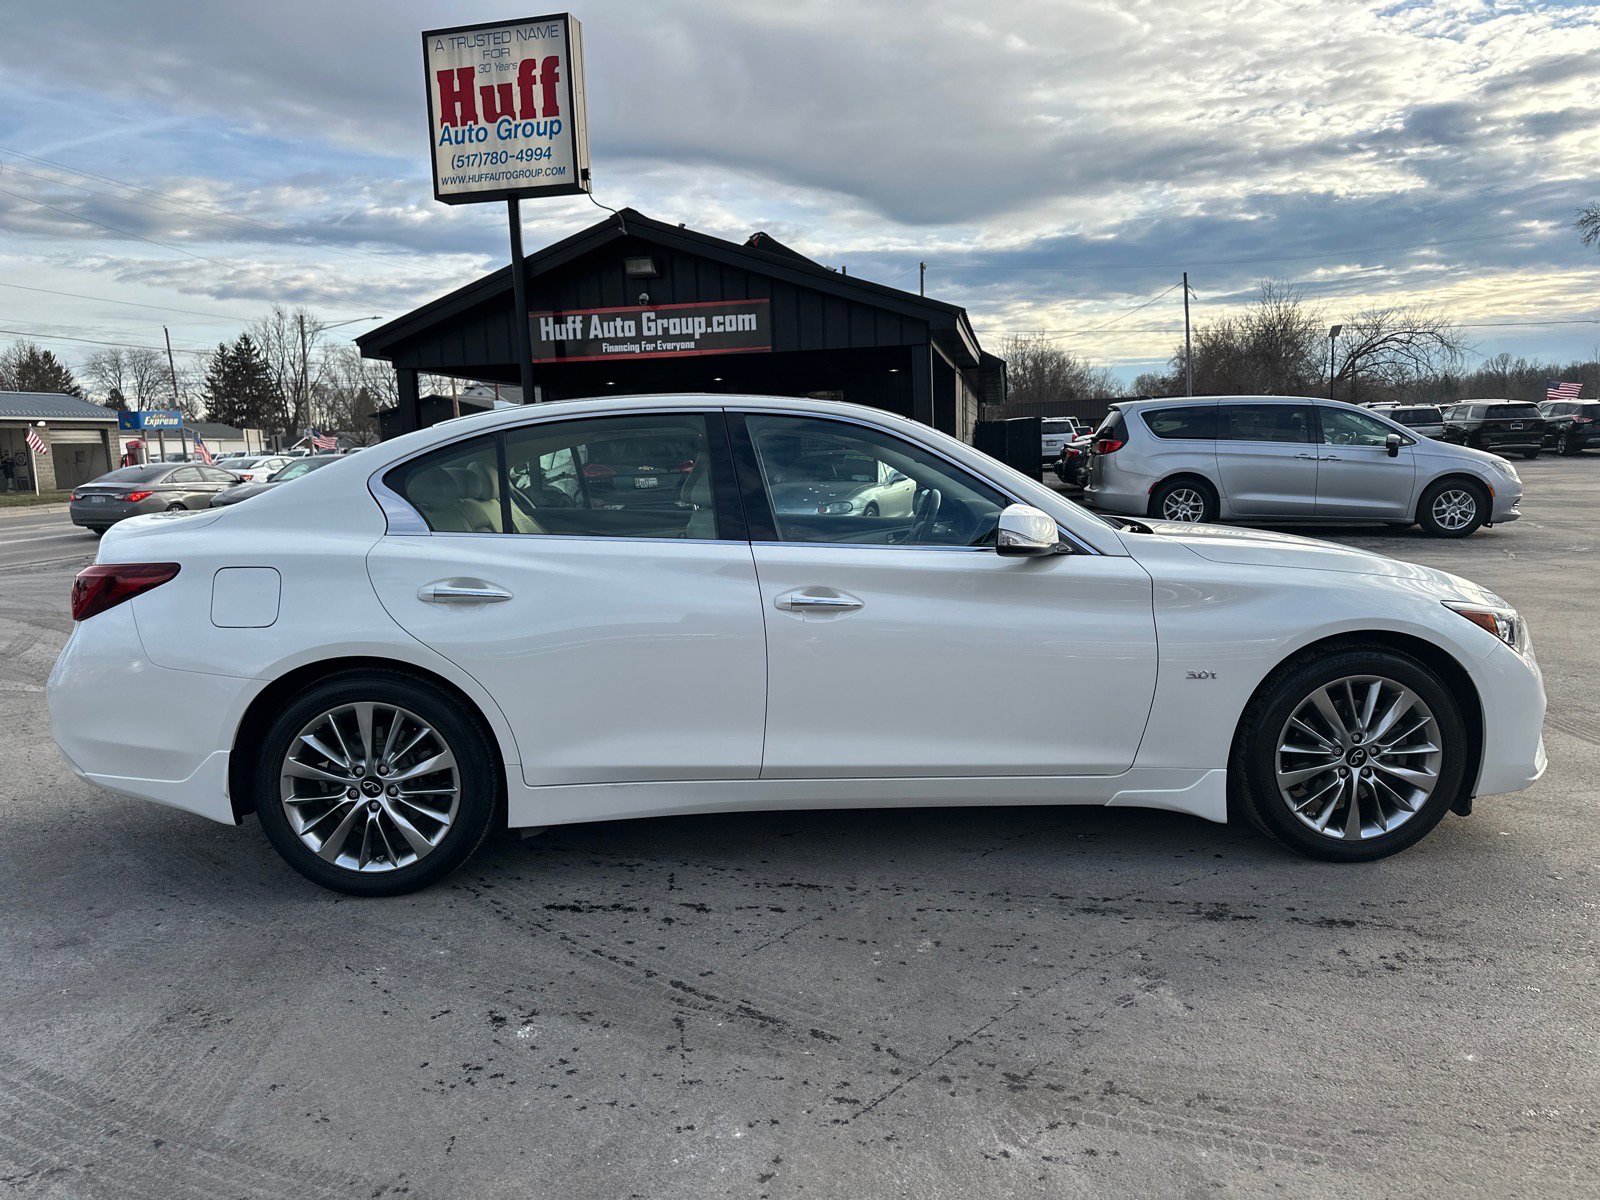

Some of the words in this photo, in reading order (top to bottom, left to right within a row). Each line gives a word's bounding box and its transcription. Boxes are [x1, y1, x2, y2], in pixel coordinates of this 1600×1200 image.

[435, 39, 445, 52] A
[449, 30, 512, 50] TRUSTED
[516, 24, 559, 42] NAME
[483, 48, 511, 60] FOR
[478, 63, 492, 74] 30
[494, 61, 518, 72] Years
[437, 55, 560, 128] Huff
[439, 124, 488, 147] Auto
[496, 118, 563, 141] Group
[451, 146, 552, 170] (517)780-4994
[441, 166, 566, 186] WWW.HUFFAUTOGROUP.COM
[539, 316, 583, 342] Huff
[589, 314, 636, 340] Auto
[641, 311, 757, 339] Group.com
[602, 342, 640, 354] Financing
[641, 341, 656, 352] For
[657, 340, 695, 351] Everyone
